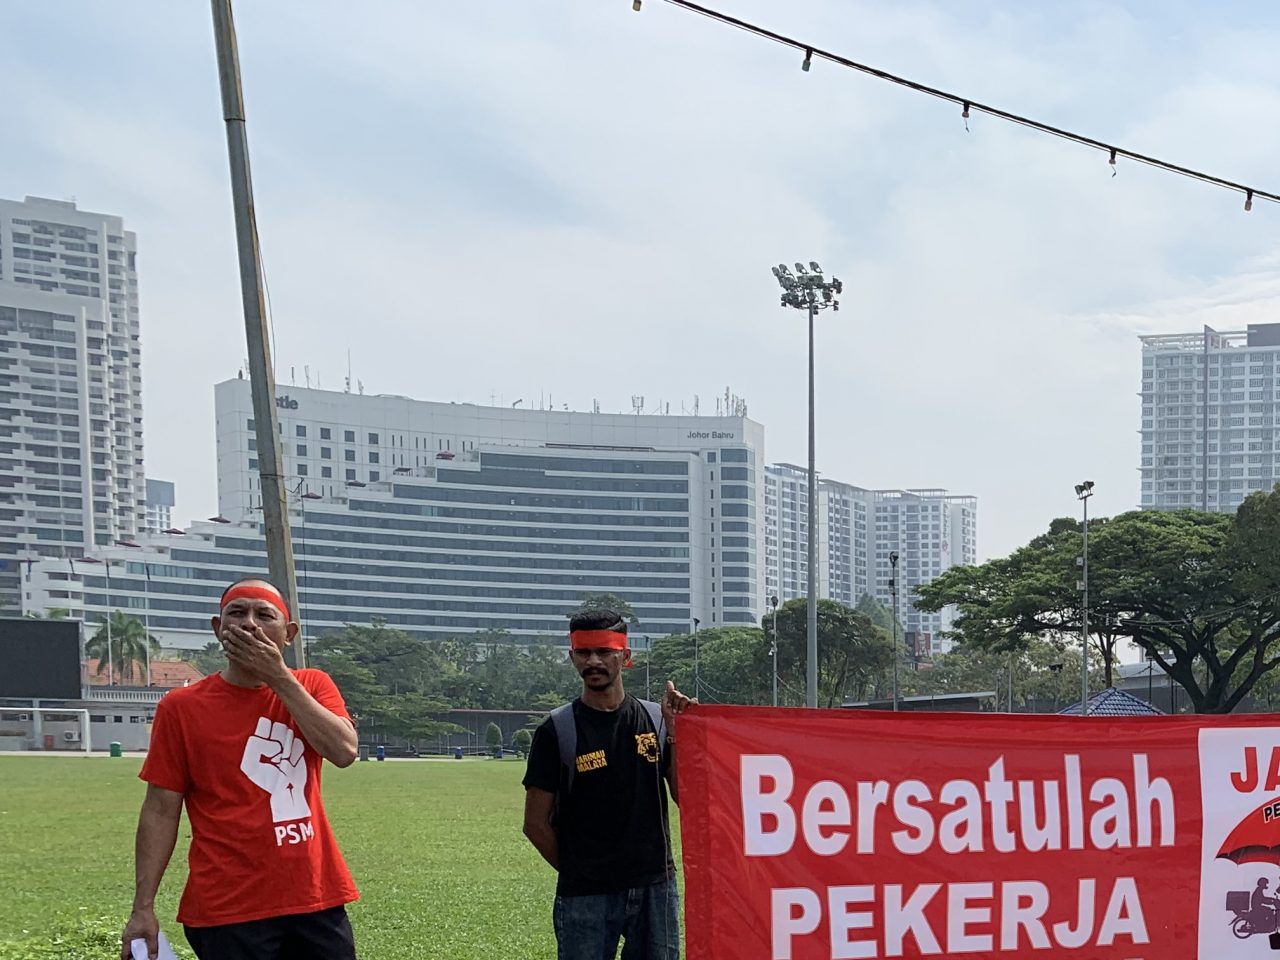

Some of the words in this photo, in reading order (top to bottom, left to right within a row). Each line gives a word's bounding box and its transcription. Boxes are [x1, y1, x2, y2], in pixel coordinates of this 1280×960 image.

[687, 431, 710, 439] Johor
[711, 431, 735, 439] Bahru
[740, 753, 1175, 857] Bersatulah
[274, 820, 315, 847] PSM
